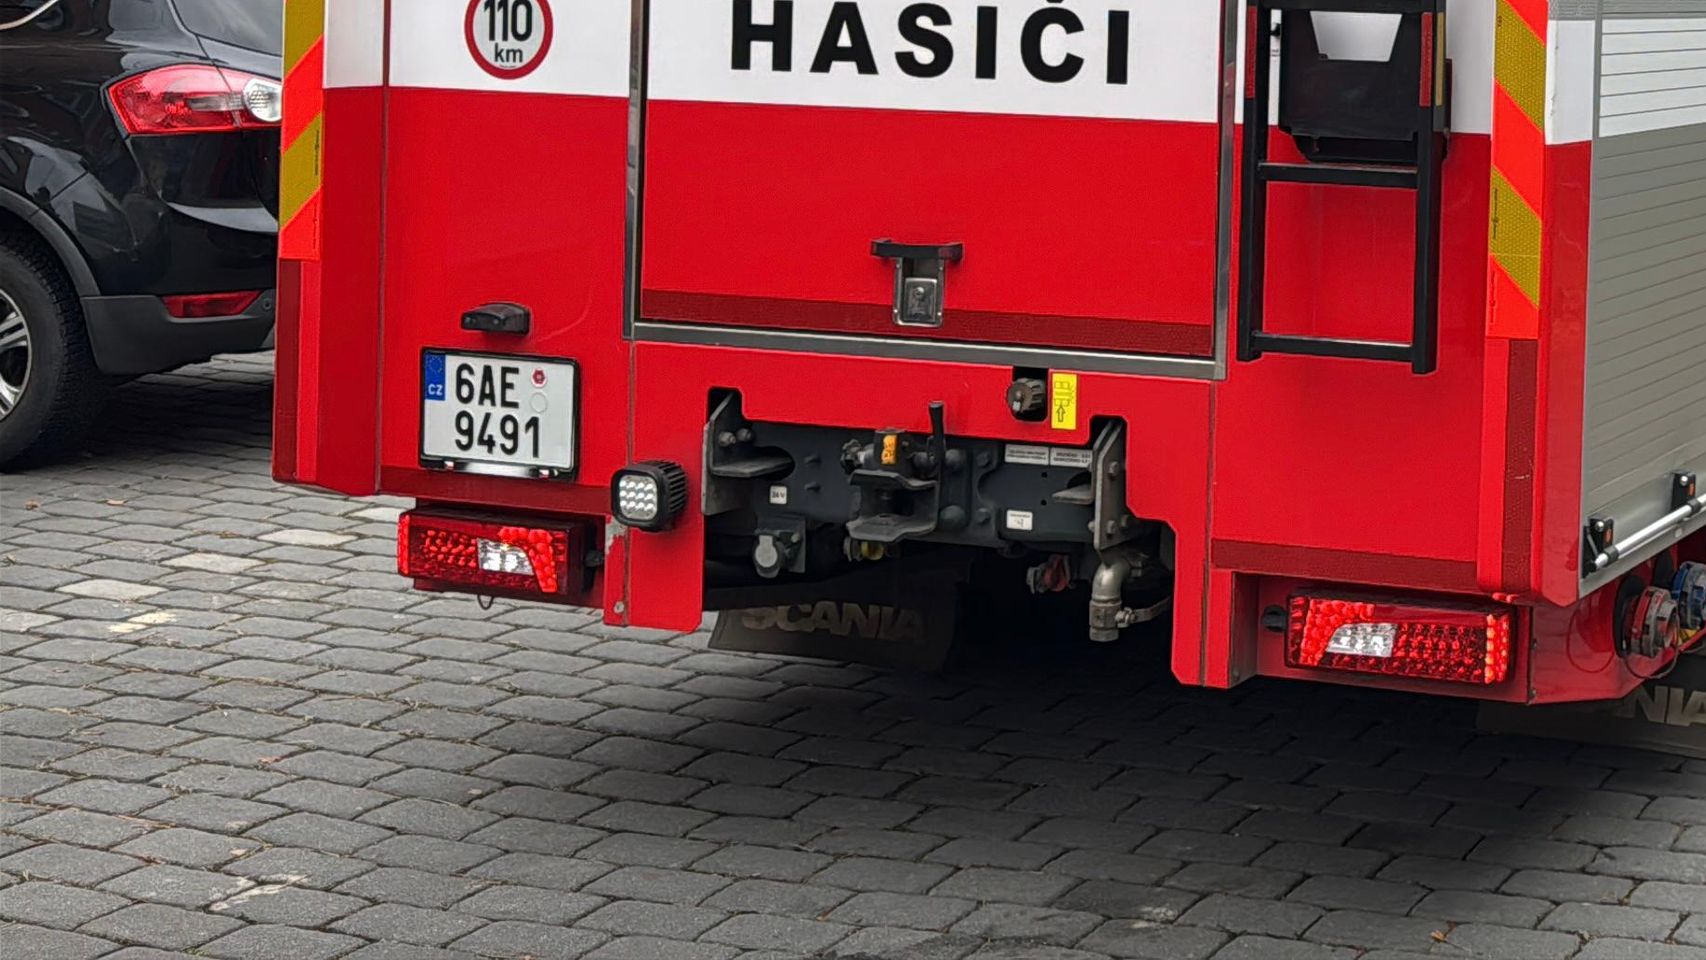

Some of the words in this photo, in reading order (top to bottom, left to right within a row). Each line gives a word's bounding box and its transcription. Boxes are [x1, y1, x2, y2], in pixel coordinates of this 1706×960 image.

[494, 43, 523, 63] km
[428, 383, 443, 396] CZ
[455, 363, 520, 409] 6AE
[454, 410, 540, 458] 9491
[742, 600, 928, 642] SCANIA
